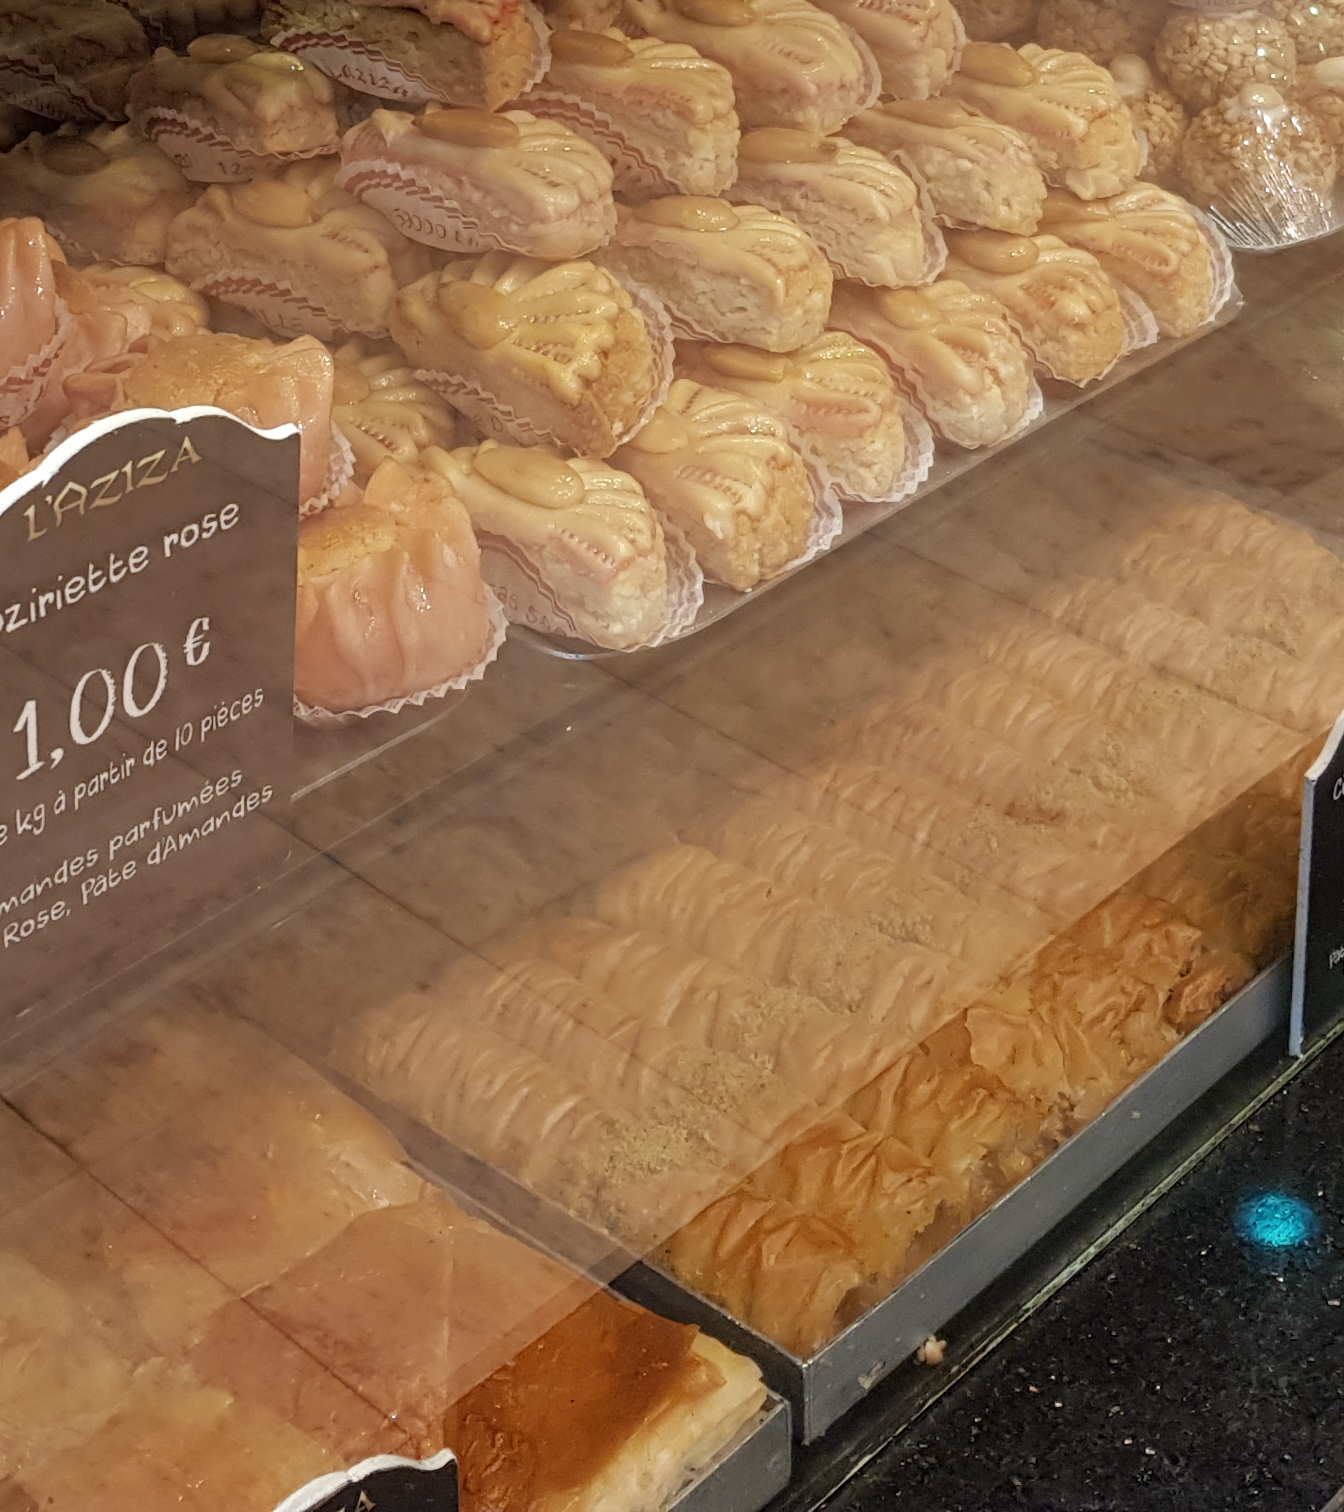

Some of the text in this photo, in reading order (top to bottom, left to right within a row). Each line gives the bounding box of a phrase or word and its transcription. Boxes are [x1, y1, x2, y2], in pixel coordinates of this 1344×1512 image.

[25, 435, 202, 542] L'AZIZA
[163, 501, 240, 558] rose
[12, 617, 213, 781] 1,00 €
[15, 803, 46, 835] kg
[53, 789, 66, 815] à
[74, 752, 136, 811] partir
[142, 739, 168, 767] de
[174, 722, 194, 752] 10
[200, 688, 265, 743] pièces
[108, 769, 244, 861] parfumées
[2, 900, 72, 949] Rose,
[80, 860, 138, 906] Pâte
